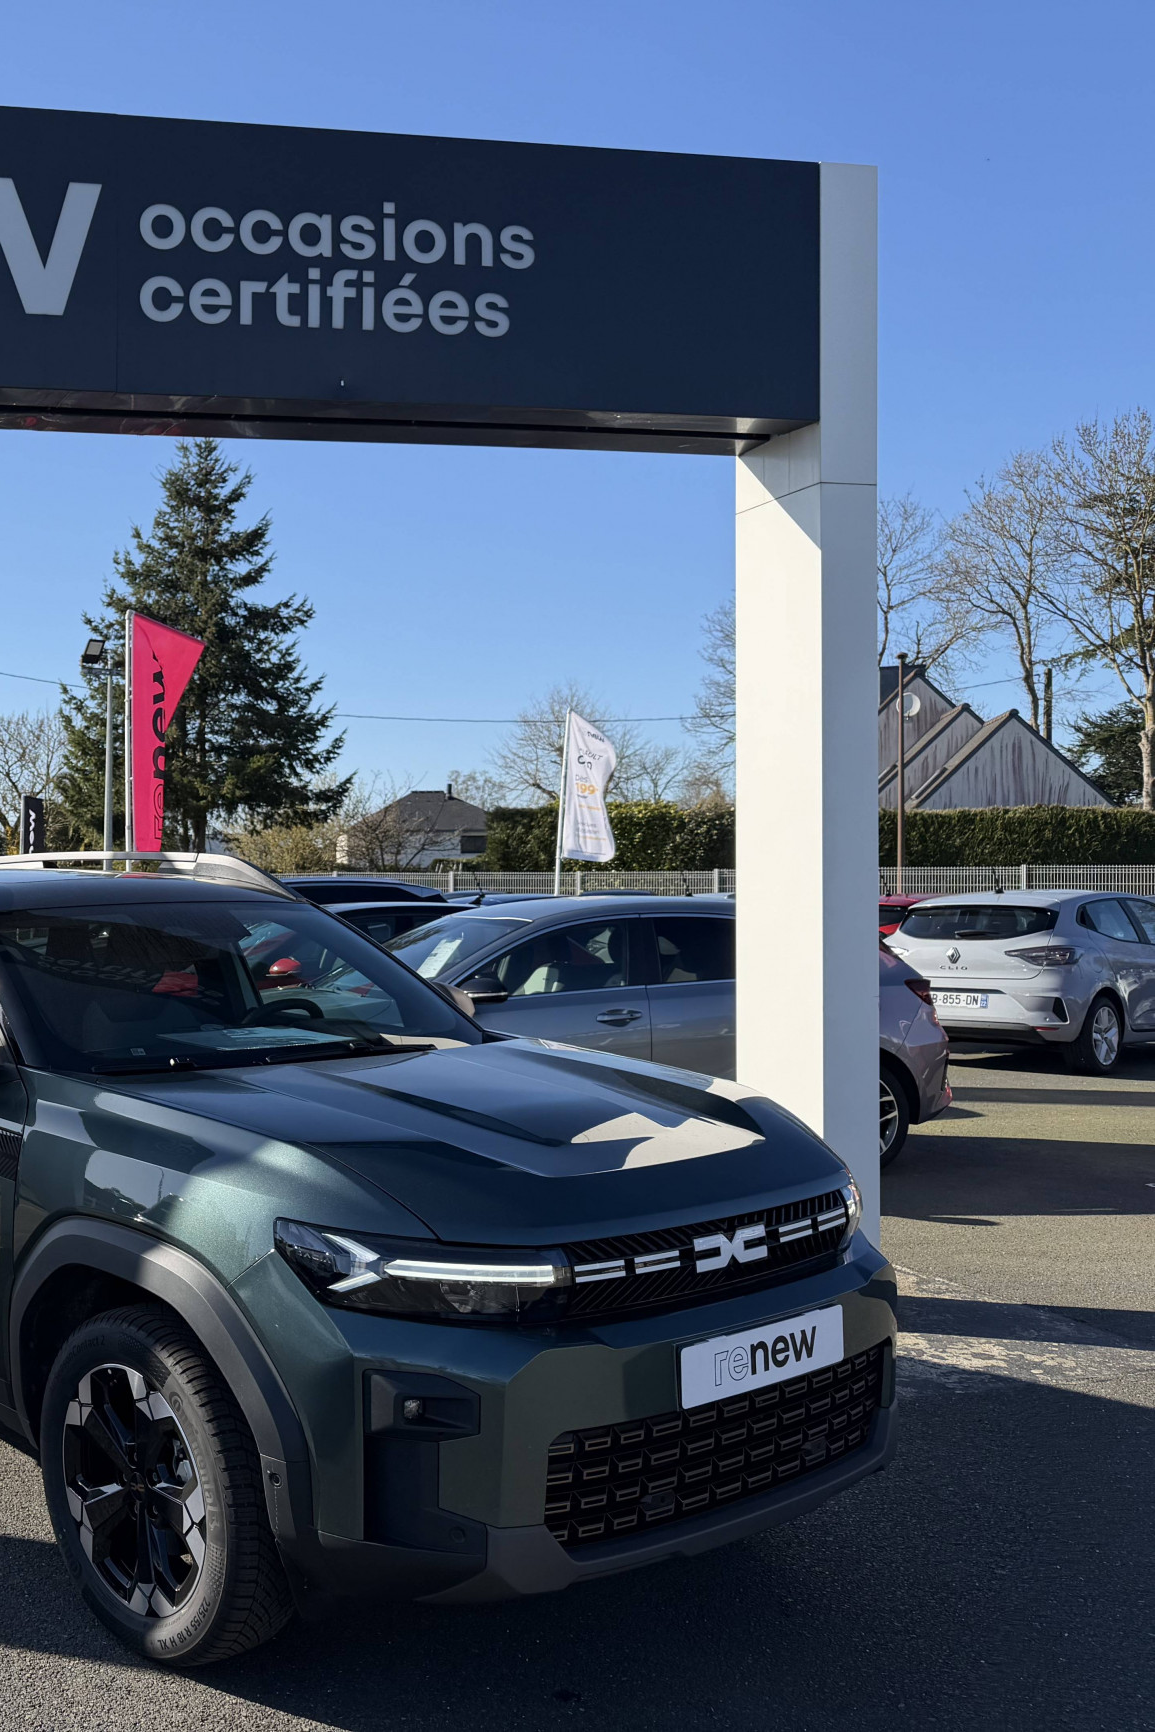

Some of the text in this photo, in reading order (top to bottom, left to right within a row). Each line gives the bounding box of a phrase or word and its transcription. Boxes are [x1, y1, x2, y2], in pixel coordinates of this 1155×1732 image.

[139, 202, 536, 270] occasions
[139, 267, 511, 338] certifiées
[932, 993, 979, 1006] B-855-DN
[714, 1325, 817, 1387] renew
[190, 1596, 211, 1631] 225/55
[176, 1632, 187, 1643] 18
[184, 1625, 193, 1638] R
[157, 1638, 170, 1651] XL
[169, 1636, 178, 1648] H
